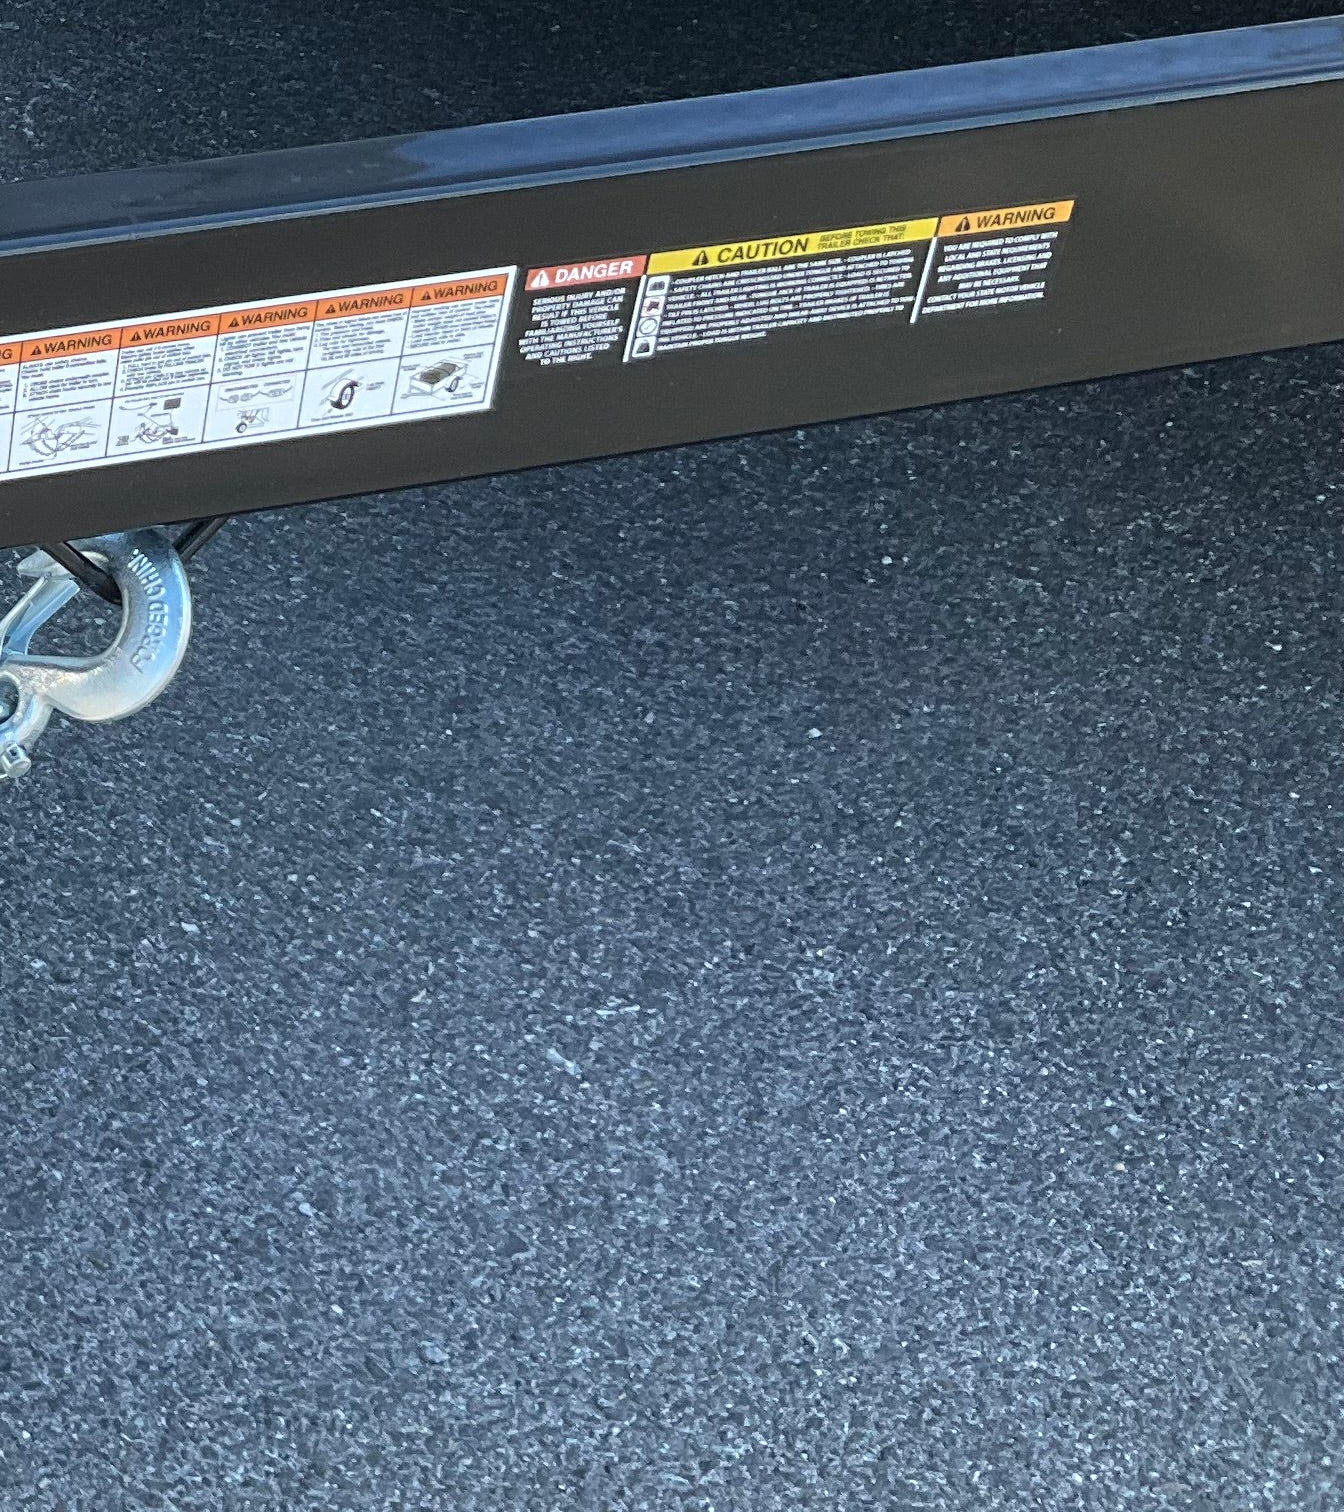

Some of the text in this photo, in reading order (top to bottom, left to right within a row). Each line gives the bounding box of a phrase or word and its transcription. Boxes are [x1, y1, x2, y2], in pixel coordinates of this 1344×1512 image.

[977, 207, 1055, 228] WARNING
[717, 238, 810, 264] CAUTION
[555, 261, 633, 283] DANGER
[433, 280, 498, 300] WARNING
[338, 293, 404, 313] WARNING
[241, 306, 308, 326] WARNING
[143, 320, 211, 340] WARNING
[44, 334, 113, 354] WARNING
